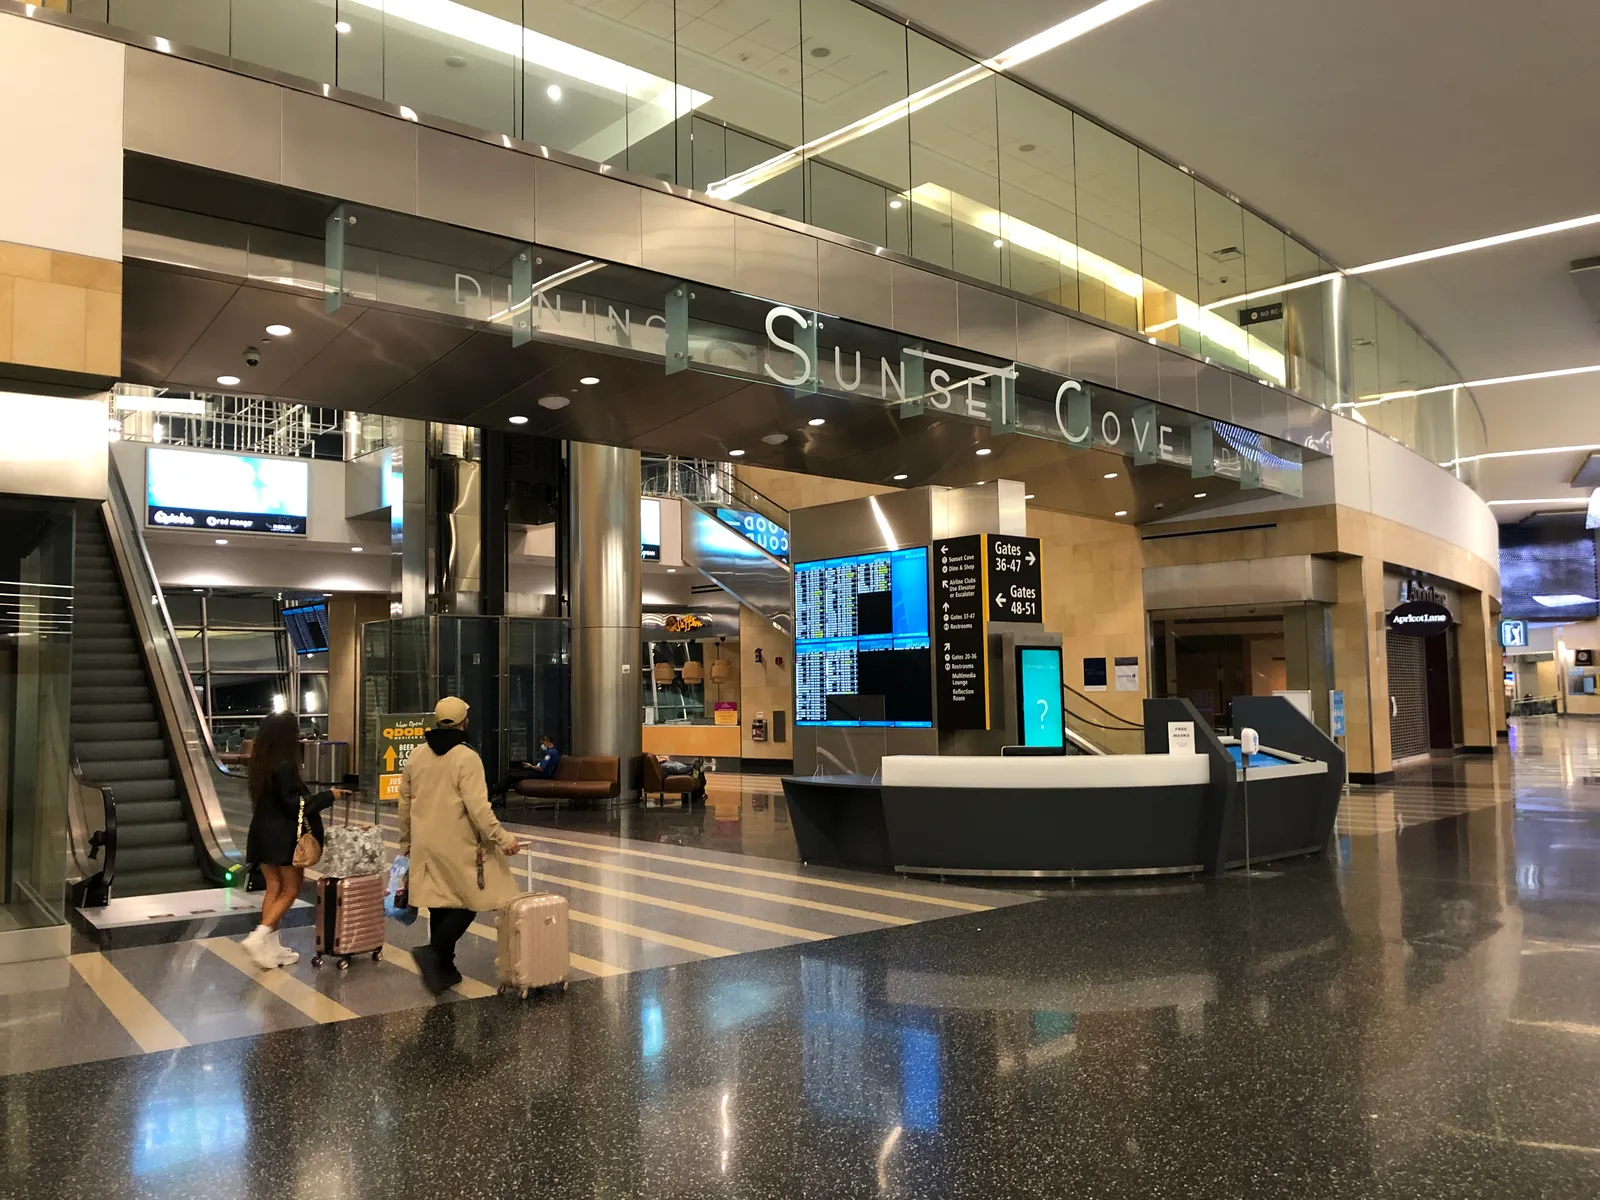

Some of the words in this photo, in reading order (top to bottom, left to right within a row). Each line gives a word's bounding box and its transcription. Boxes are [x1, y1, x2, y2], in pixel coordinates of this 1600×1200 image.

[995, 541, 1021, 556] Gates
[963, 563, 975, 571] Shop
[995, 557, 1021, 572] 36-47
[1010, 584, 1036, 599] Gates
[1010, 601, 1036, 615] 48-51
[386, 786, 399, 794] STE
